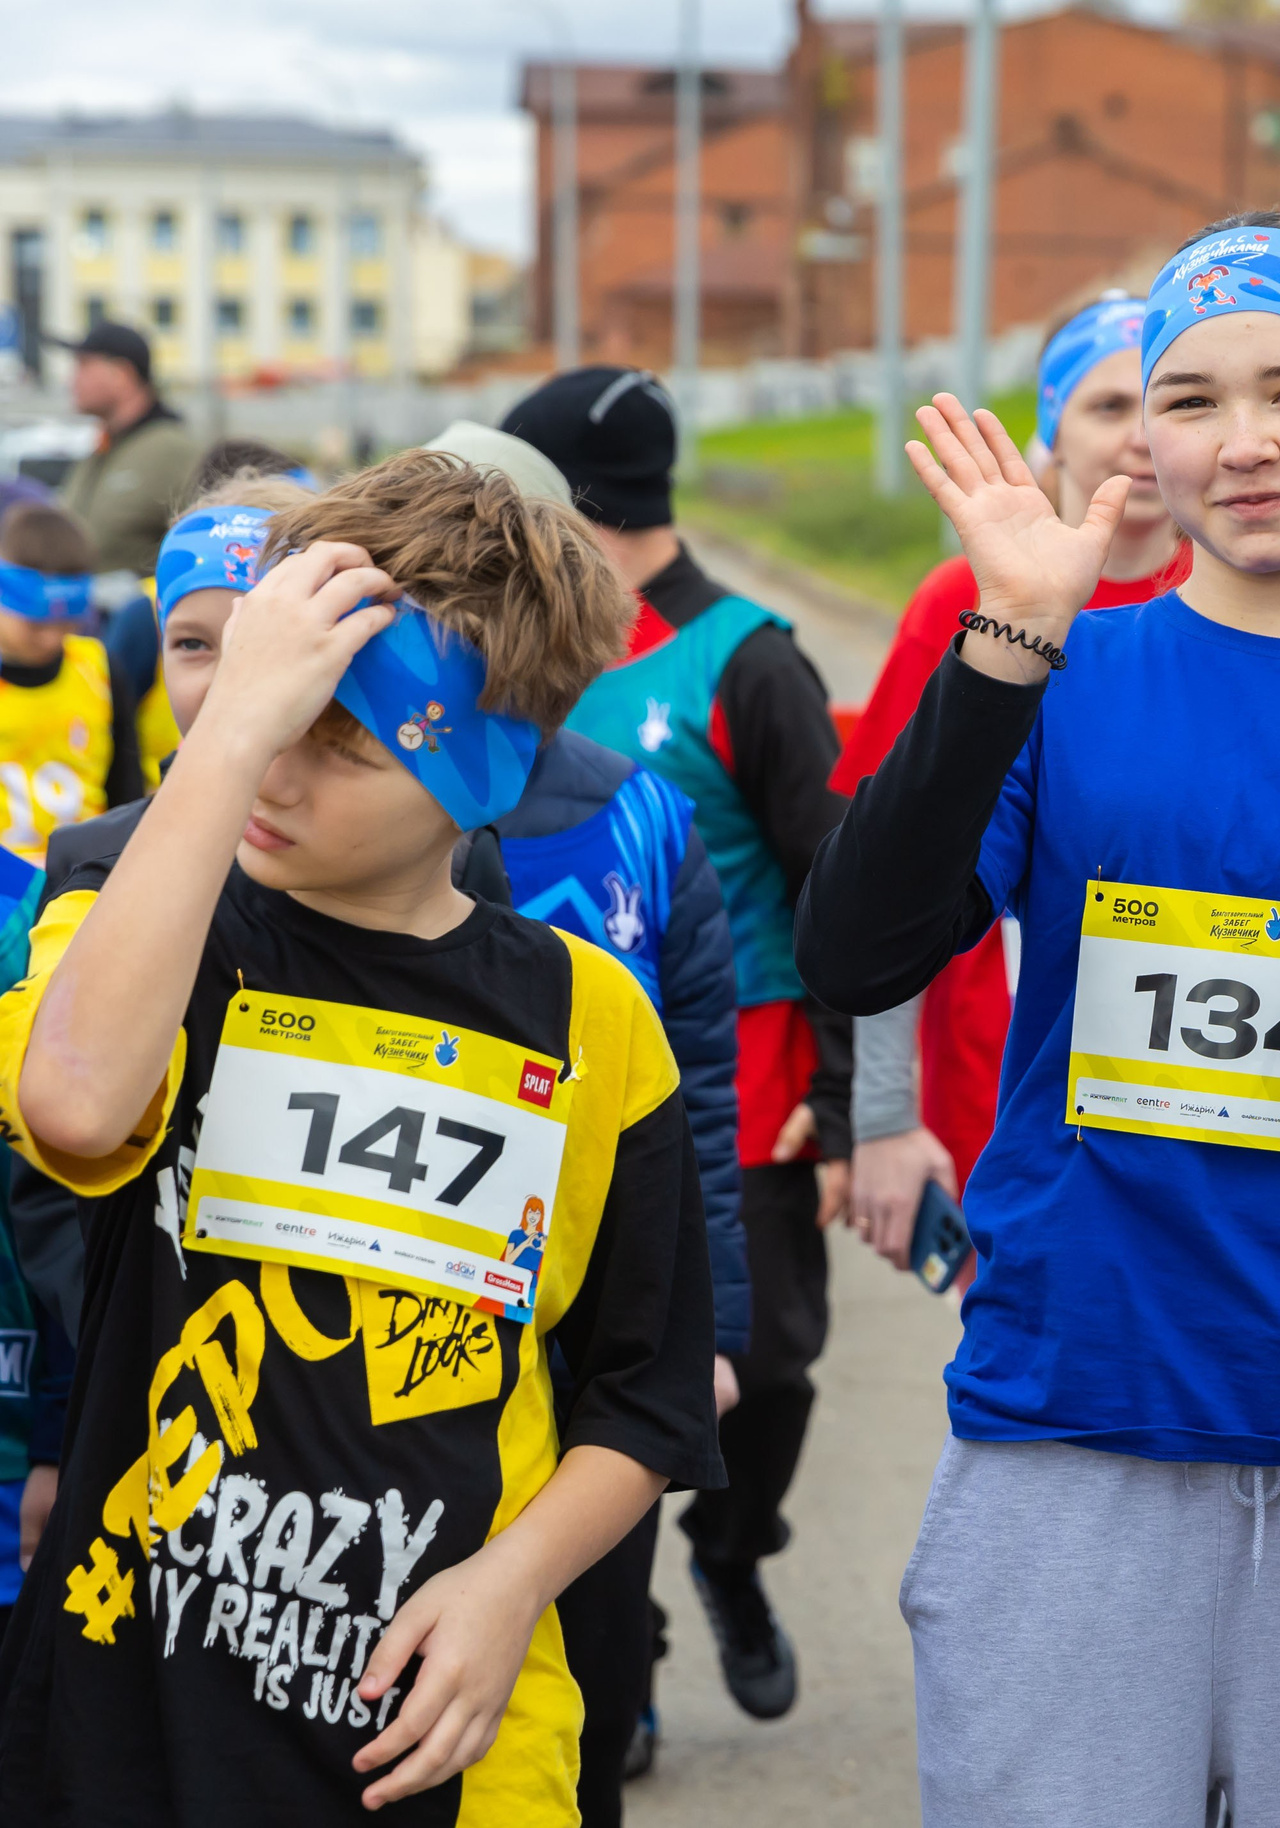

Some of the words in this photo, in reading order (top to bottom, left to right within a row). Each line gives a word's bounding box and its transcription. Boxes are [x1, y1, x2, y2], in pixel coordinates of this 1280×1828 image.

[1113, 898, 1159, 917] 500
[1112, 916, 1156, 927] метров
[261, 1009, 316, 1031] 500
[259, 1027, 311, 1042] метров
[389, 1037, 420, 1048] ЗАБЕГ
[523, 1073, 549, 1096] SPLAT
[1136, 1097, 1170, 1109] centre
[287, 1092, 507, 1207] 147
[275, 1222, 317, 1236] centre
[487, 1273, 521, 1292] GrossHaus
[203, 1582, 388, 1679] REALIT
[253, 1658, 297, 1711] IS
